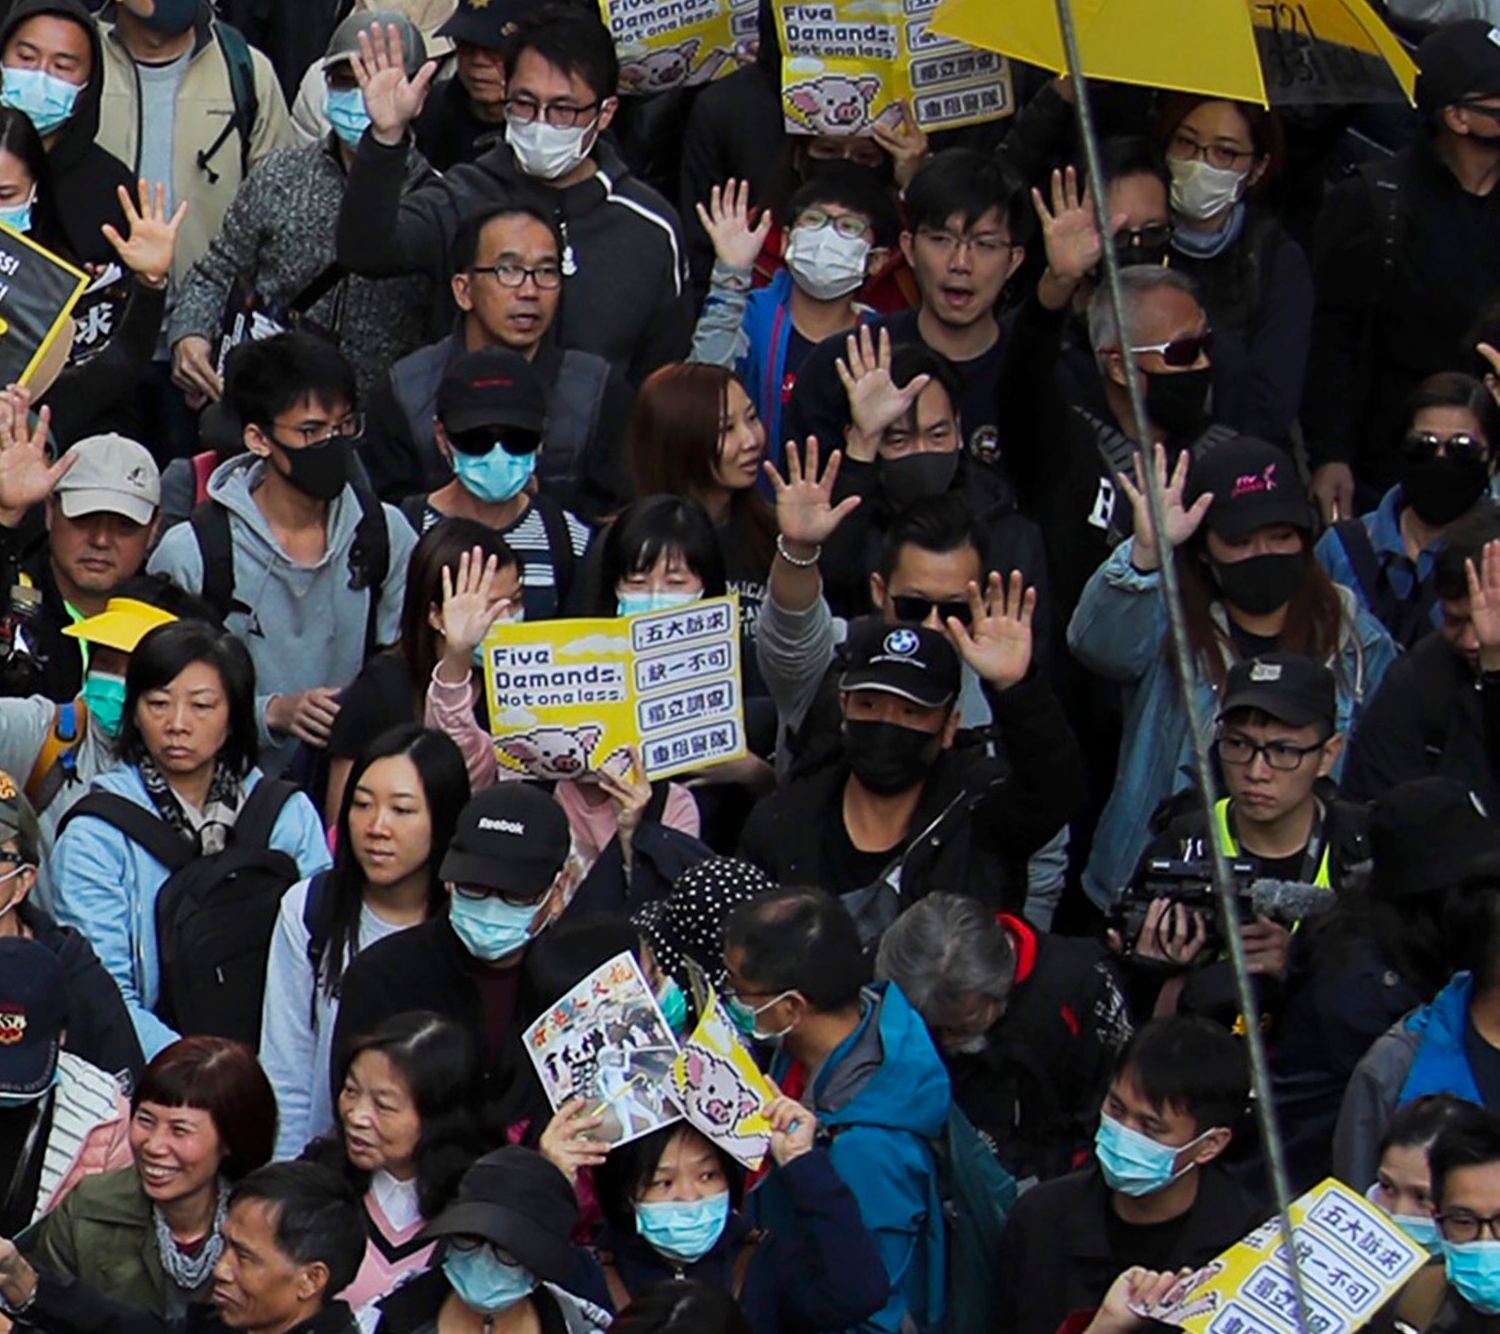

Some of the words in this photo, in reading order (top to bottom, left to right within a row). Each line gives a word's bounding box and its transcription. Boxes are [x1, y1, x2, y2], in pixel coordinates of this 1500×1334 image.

[783, 4, 833, 22] Five
[493, 648, 550, 667] Five
[497, 691, 528, 708] Not
[533, 691, 564, 706] one
